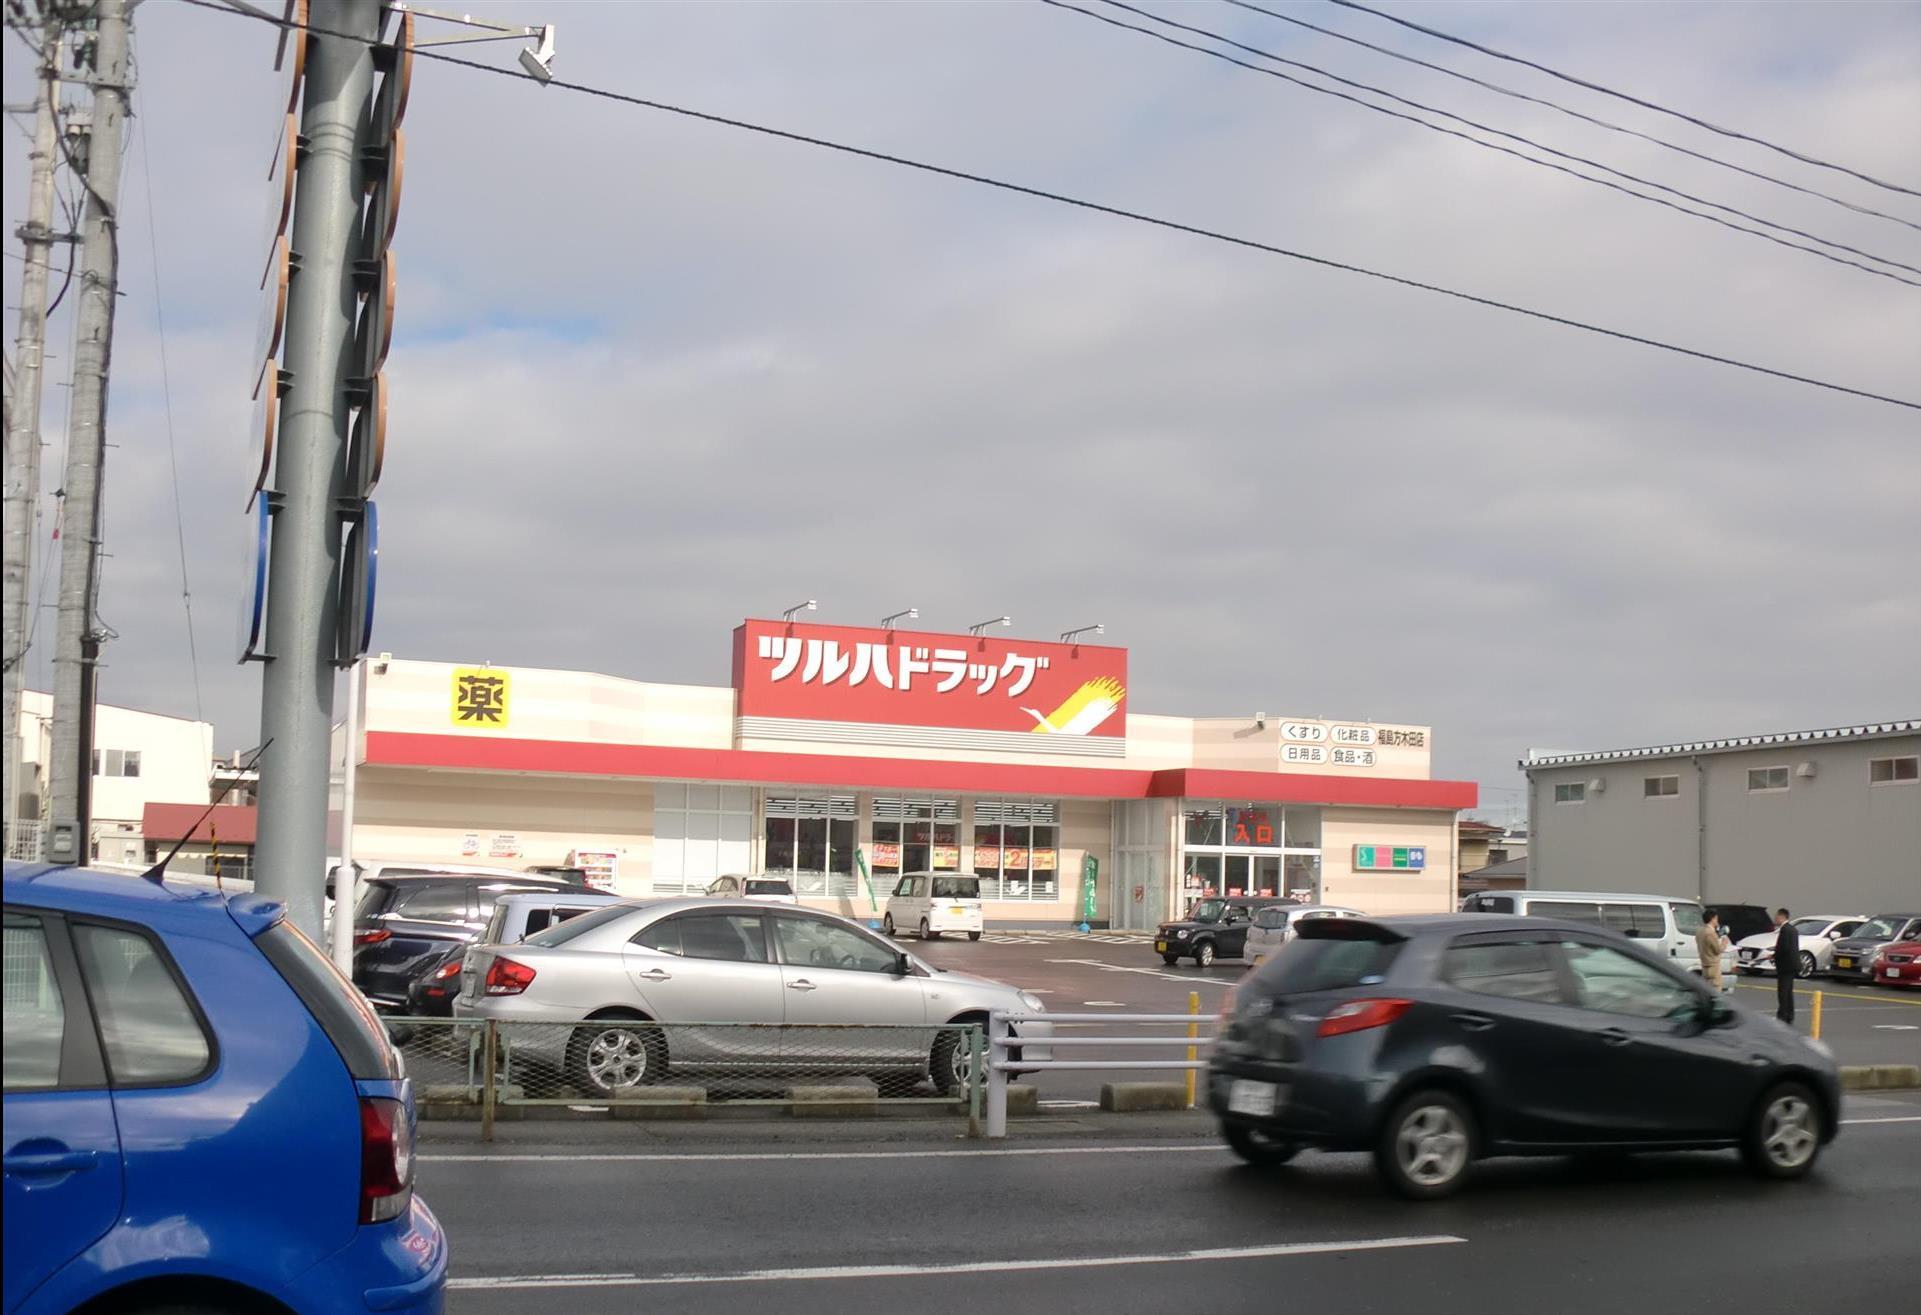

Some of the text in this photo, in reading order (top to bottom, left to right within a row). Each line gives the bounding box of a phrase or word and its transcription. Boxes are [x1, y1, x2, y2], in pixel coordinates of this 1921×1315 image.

[757, 635, 1050, 697] ツルハドラッグ
[457, 674, 504, 723] 薬
[1287, 725, 1321, 740] くすり
[1337, 728, 1370, 742] 化粧品
[1288, 747, 1321, 760] 日用品
[1334, 749, 1374, 764] 食品・酒
[1234, 824, 1273, 844] 入口
